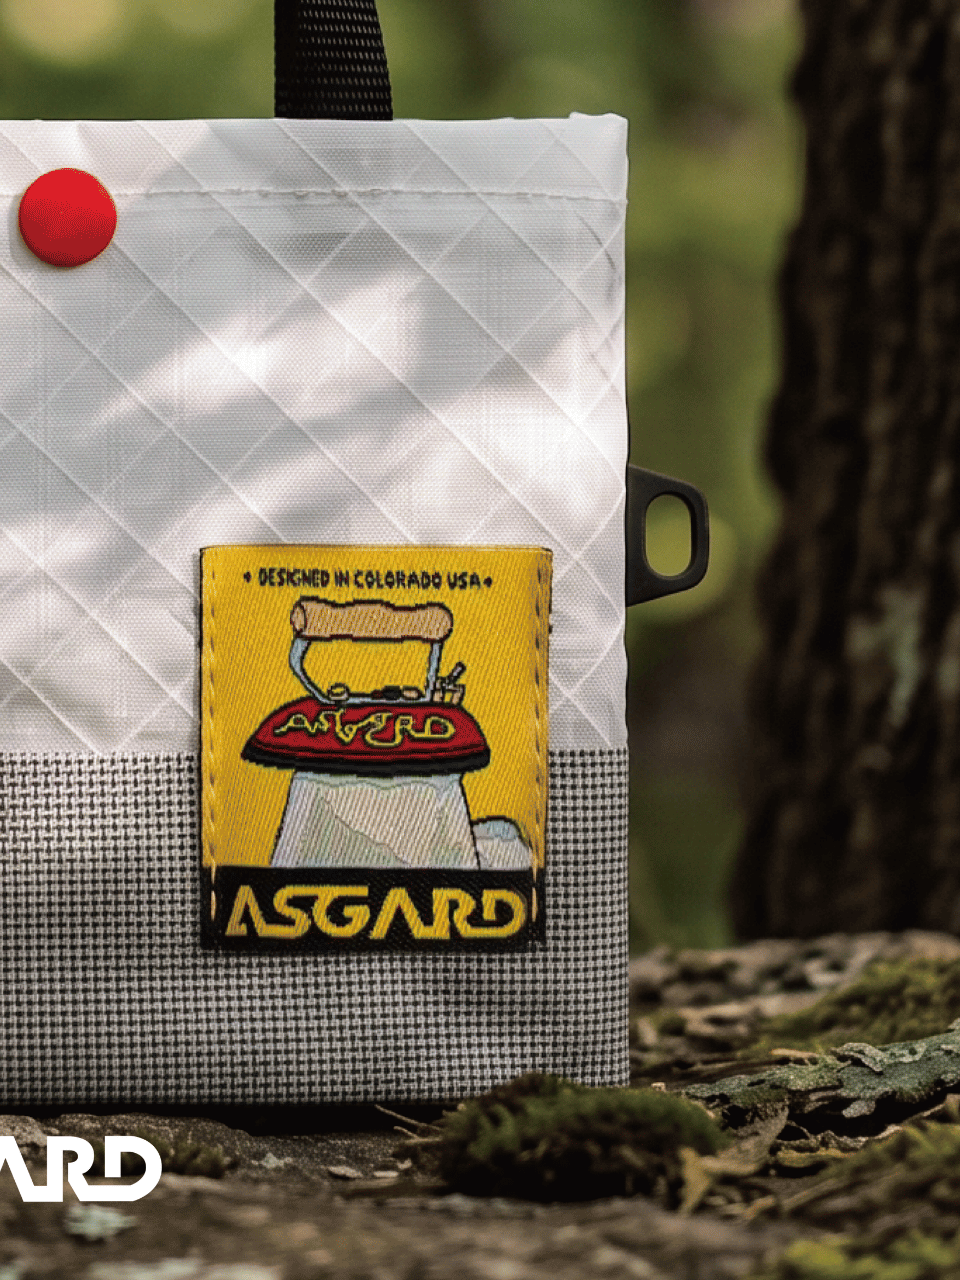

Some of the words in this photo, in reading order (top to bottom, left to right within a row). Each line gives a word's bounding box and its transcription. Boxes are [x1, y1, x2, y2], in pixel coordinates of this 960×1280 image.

[258, 568, 330, 588] DESIGNED
[334, 570, 350, 588] IN
[353, 570, 443, 590] COLORADO
[447, 571, 481, 591] USA
[225, 884, 527, 940] ASGARD
